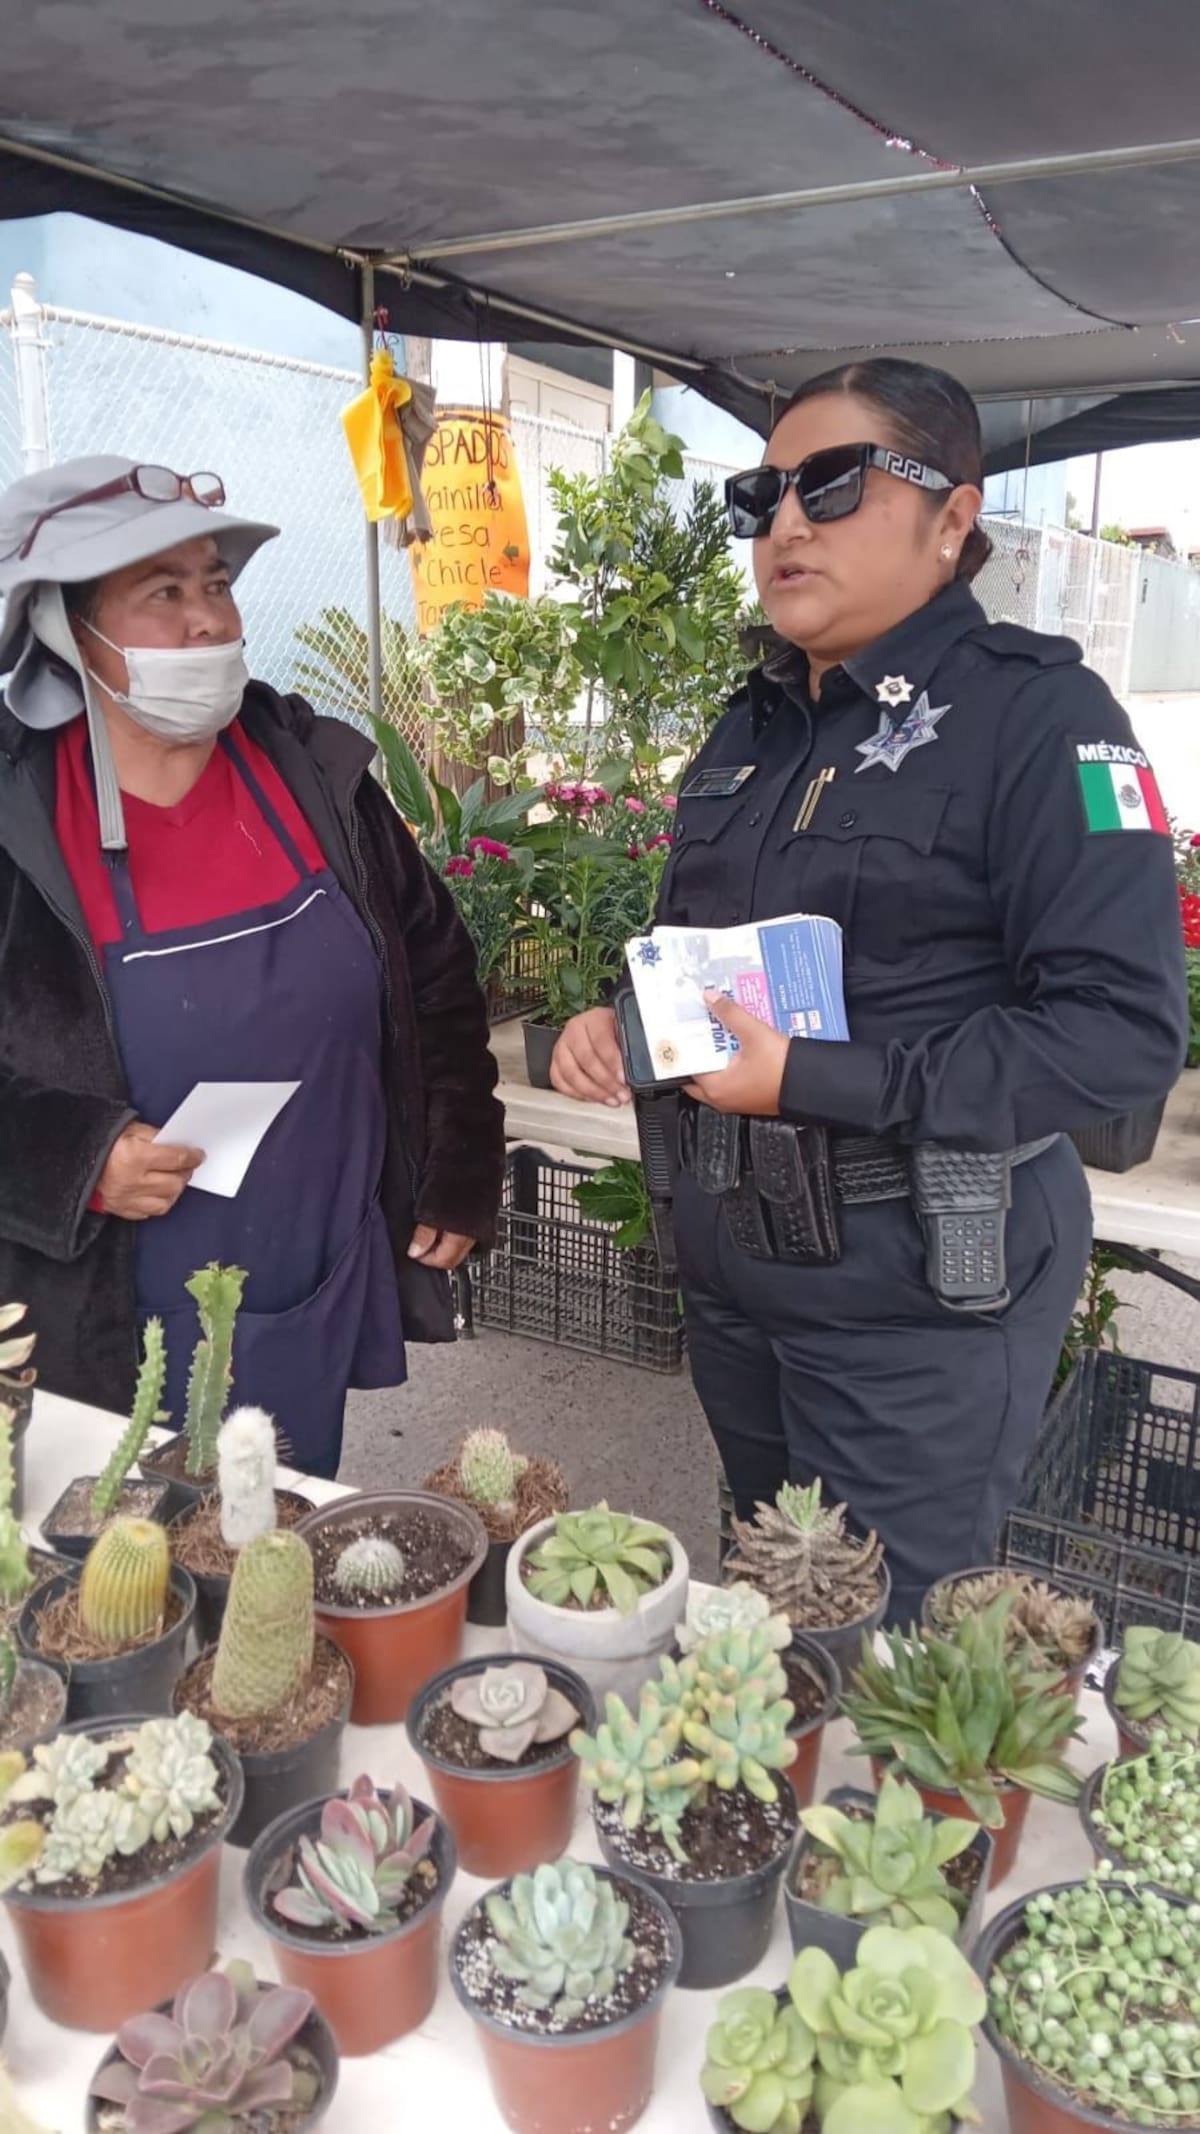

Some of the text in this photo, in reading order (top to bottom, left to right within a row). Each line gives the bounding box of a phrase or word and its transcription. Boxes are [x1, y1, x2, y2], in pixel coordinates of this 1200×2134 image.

[424, 428, 508, 469] SPADOS
[424, 524, 490, 552] resa
[427, 557, 503, 587] Chicle
[1076, 740, 1149, 768] MÉXICO
